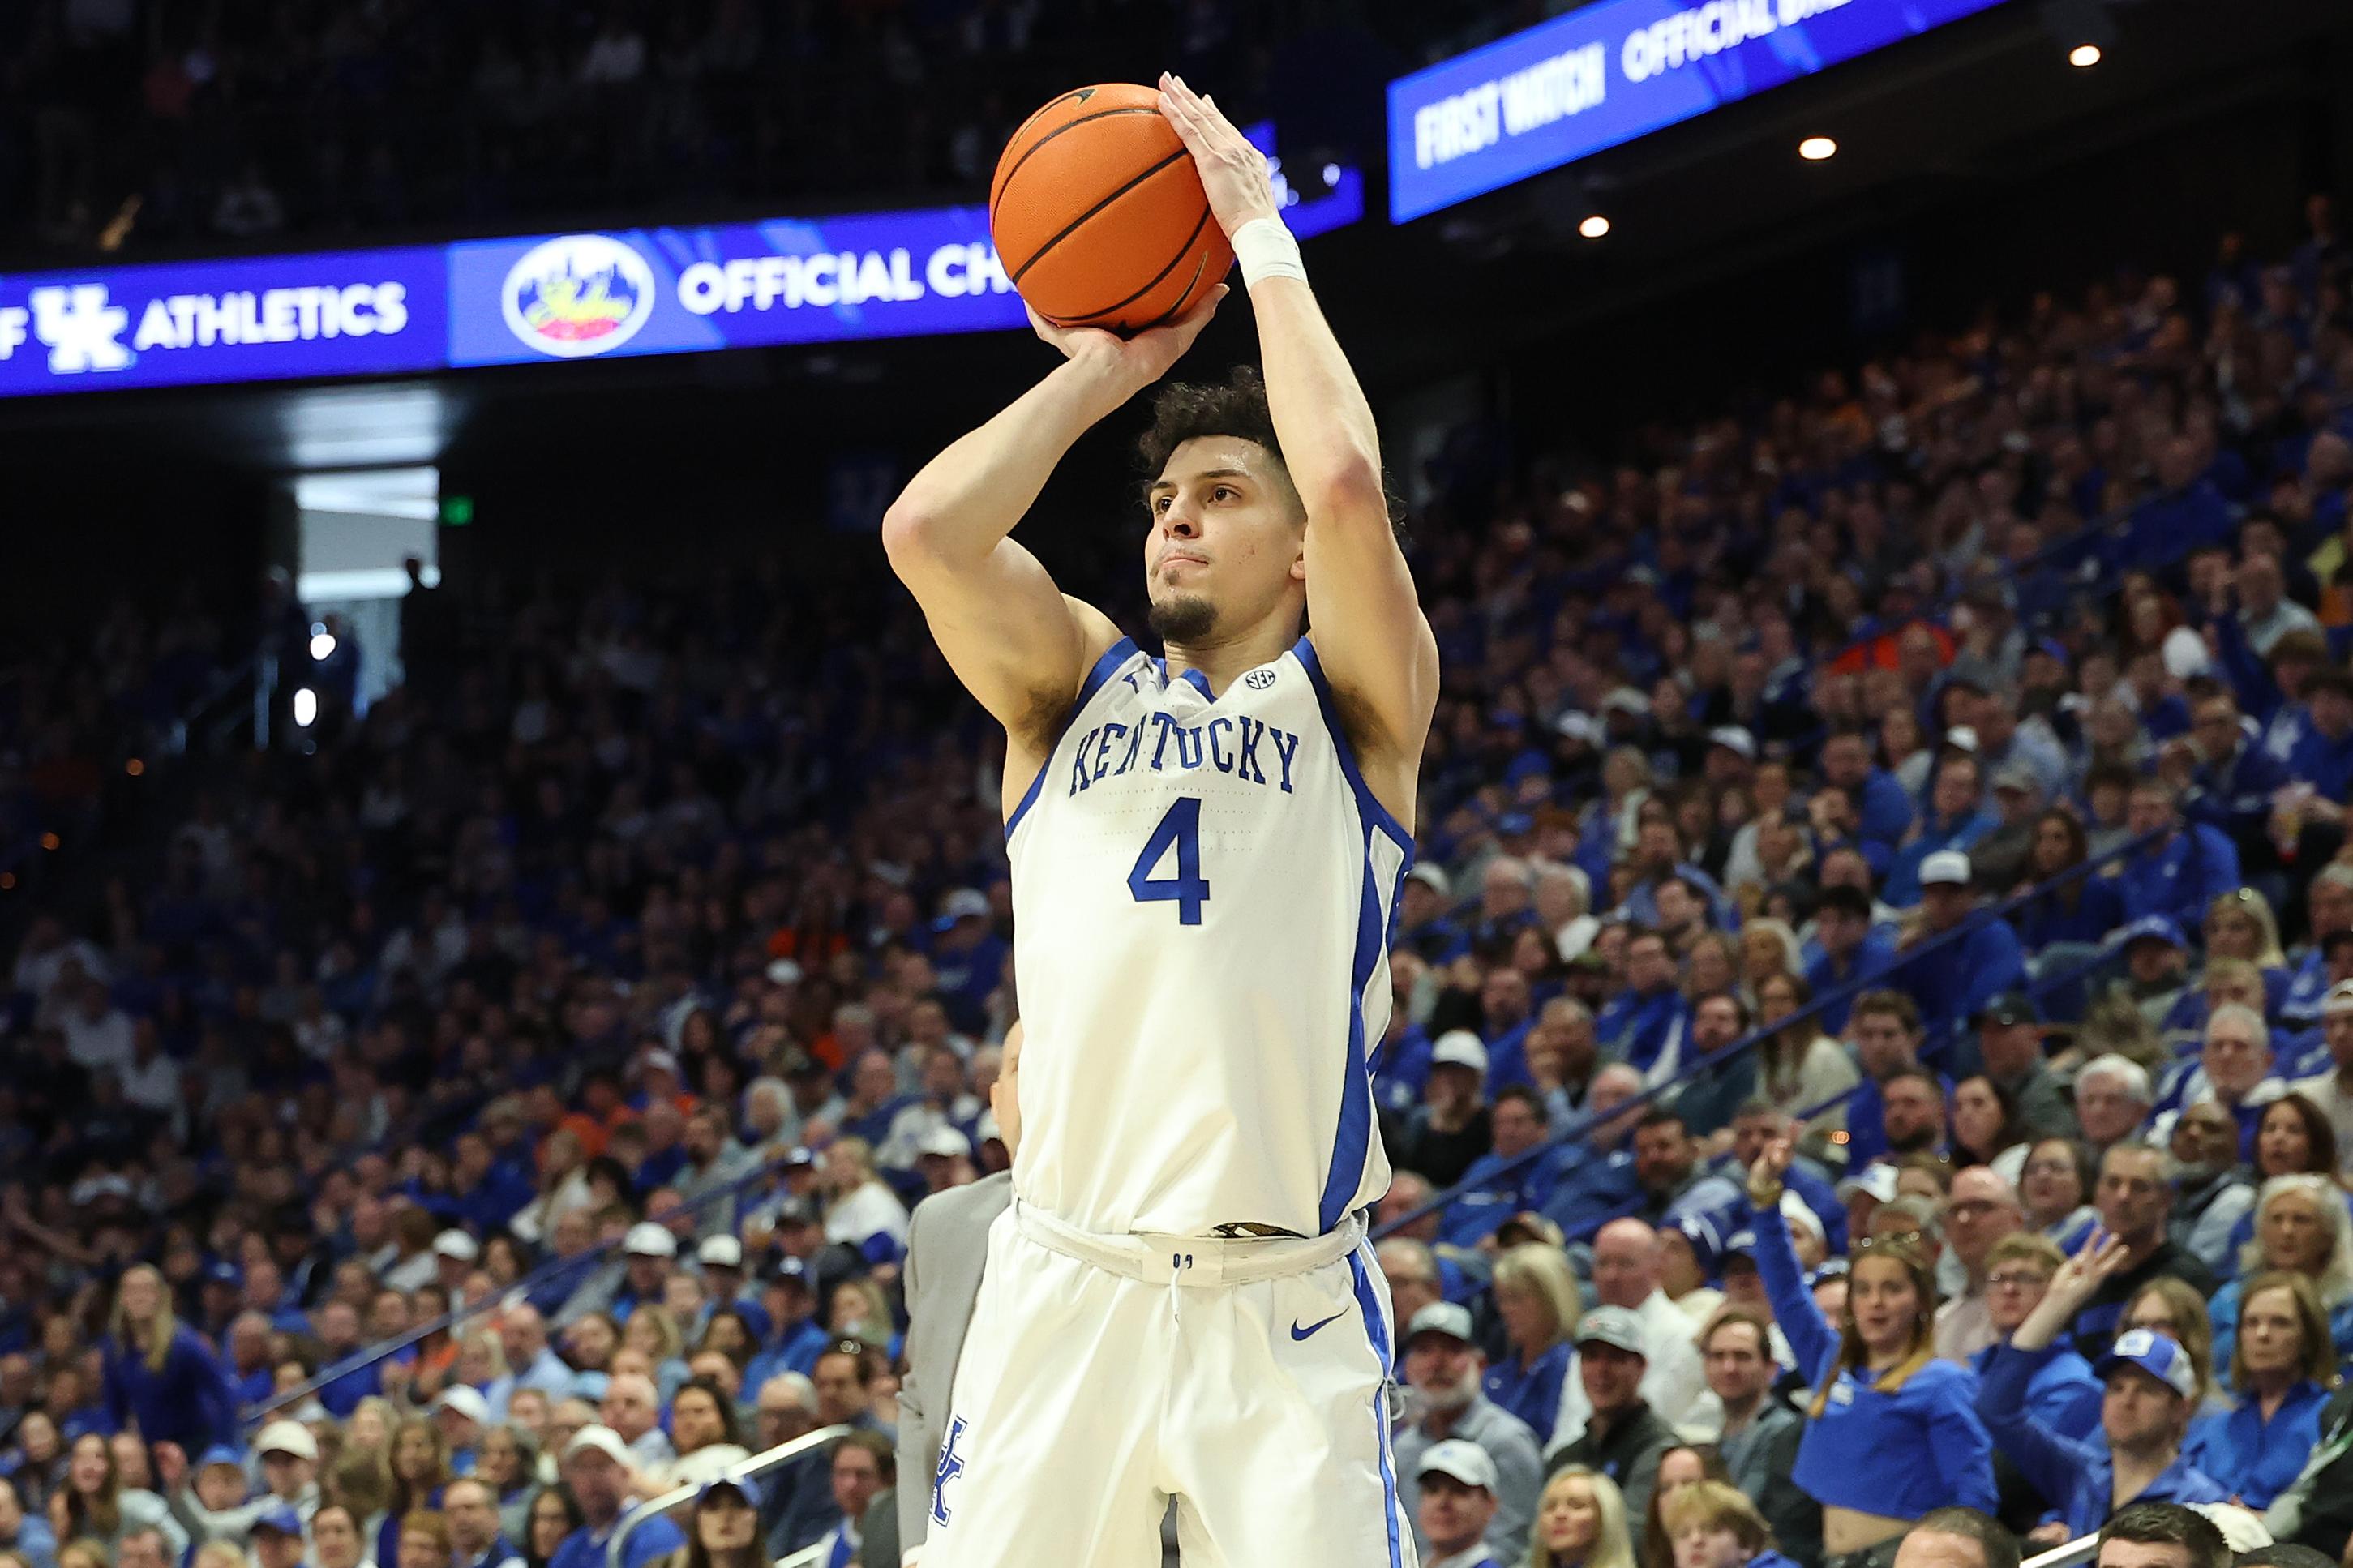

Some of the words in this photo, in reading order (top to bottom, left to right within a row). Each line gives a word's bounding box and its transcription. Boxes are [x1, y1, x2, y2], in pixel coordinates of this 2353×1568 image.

[1622, 0, 1777, 83] OFFICIAL
[1414, 79, 1500, 171] FIRST
[678, 246, 924, 315] OFFICIAL
[925, 242, 1019, 298] CH
[0, 306, 30, 361] F
[28, 283, 135, 375] UK
[133, 281, 407, 351] ATHLETICS
[1245, 670, 1275, 689] SEC
[1069, 711, 1299, 799] KENTUCKY
[1127, 797, 1211, 926] 4
